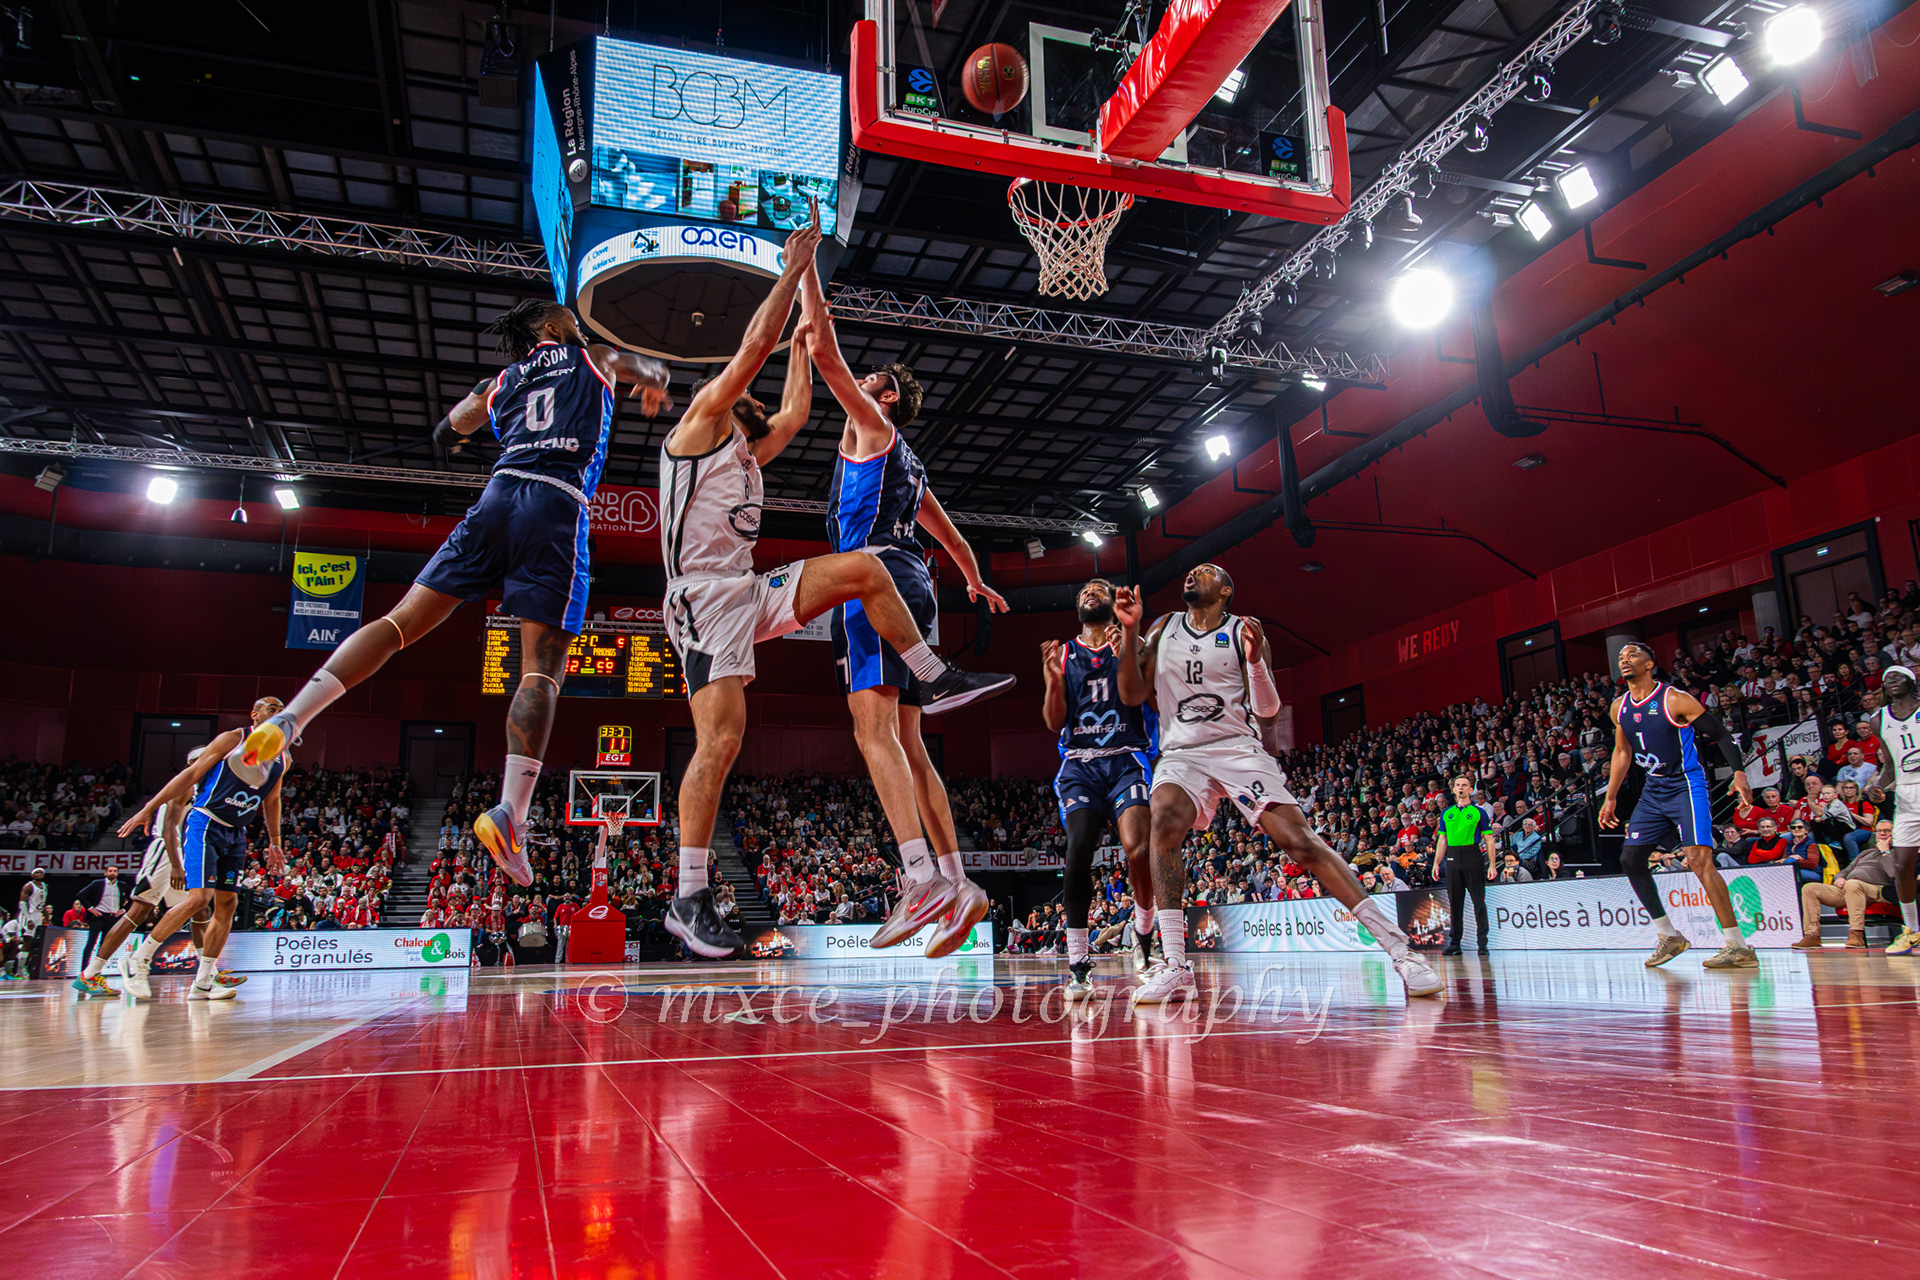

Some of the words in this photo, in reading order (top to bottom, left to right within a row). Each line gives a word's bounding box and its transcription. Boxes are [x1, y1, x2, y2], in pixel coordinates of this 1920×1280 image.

[905, 93, 937, 108] BKT
[562, 88, 574, 137] Région
[902, 104, 940, 118] EuroCup
[567, 139, 576, 156] La
[1271, 160, 1297, 173] BKT
[1269, 170, 1301, 182] EuroCup
[525, 387, 555, 432] 0
[297, 564, 317, 575] Ici,
[320, 561, 351, 573] c'est
[306, 575, 335, 587] l'Ain
[339, 575, 344, 584] !
[307, 629, 336, 641] AIN
[1398, 634, 1418, 663] WE
[1422, 619, 1459, 655] REDY
[1186, 660, 1203, 684] 12
[1087, 678, 1109, 703] 11
[1635, 732, 1646, 750] 1
[1784, 731, 1819, 747] BAPTISTE
[1900, 733, 1915, 749] 11
[0, 855, 26, 871] RG
[35, 854, 65, 869] EN
[963, 854, 982, 867] LE
[990, 853, 1028, 867] NOUS
[1497, 904, 1570, 930] Poêles
[1577, 903, 1590, 927] à
[1599, 900, 1650, 927] bois
[1754, 910, 1793, 931] Bois
[1243, 918, 1282, 937] Poêles
[1286, 917, 1292, 935] à
[1296, 916, 1325, 936] bois
[276, 936, 338, 951] Poêles
[394, 937, 434, 947] Chaleur
[973, 940, 990, 948] Bois
[274, 952, 284, 965] à
[290, 949, 373, 968] granulés
[445, 949, 466, 959] Bois
